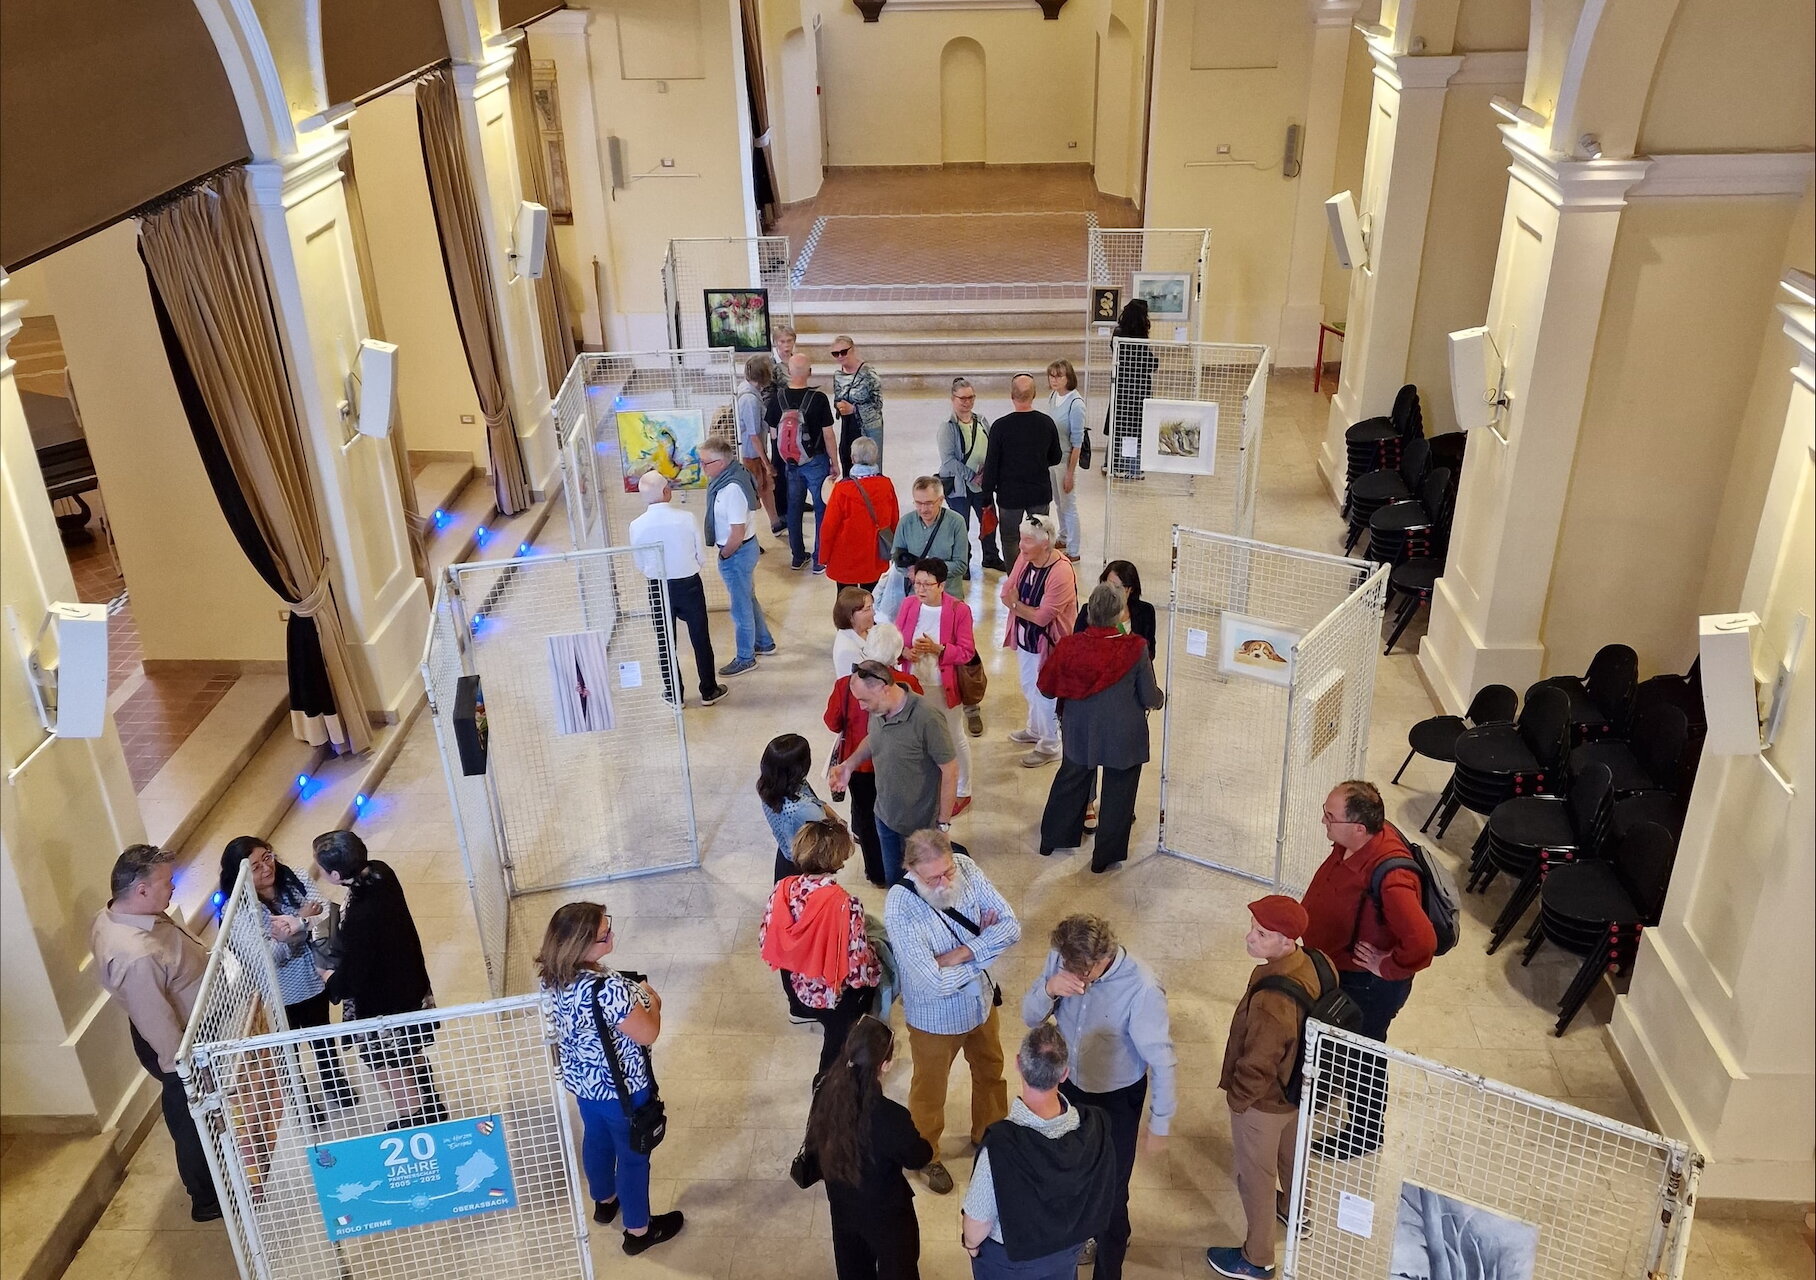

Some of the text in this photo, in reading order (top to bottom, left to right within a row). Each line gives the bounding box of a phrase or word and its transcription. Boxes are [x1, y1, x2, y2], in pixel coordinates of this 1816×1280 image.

[380, 1133, 435, 1166] 20
[387, 1159, 439, 1177] JAHRE
[388, 1169, 440, 1182] PARTNERSCHAFT
[390, 1180, 411, 1189] 2005
[420, 1174, 441, 1183] 2025
[452, 1198, 509, 1213] OBERASBACH
[336, 1219, 392, 1236] RIOLO TERME
